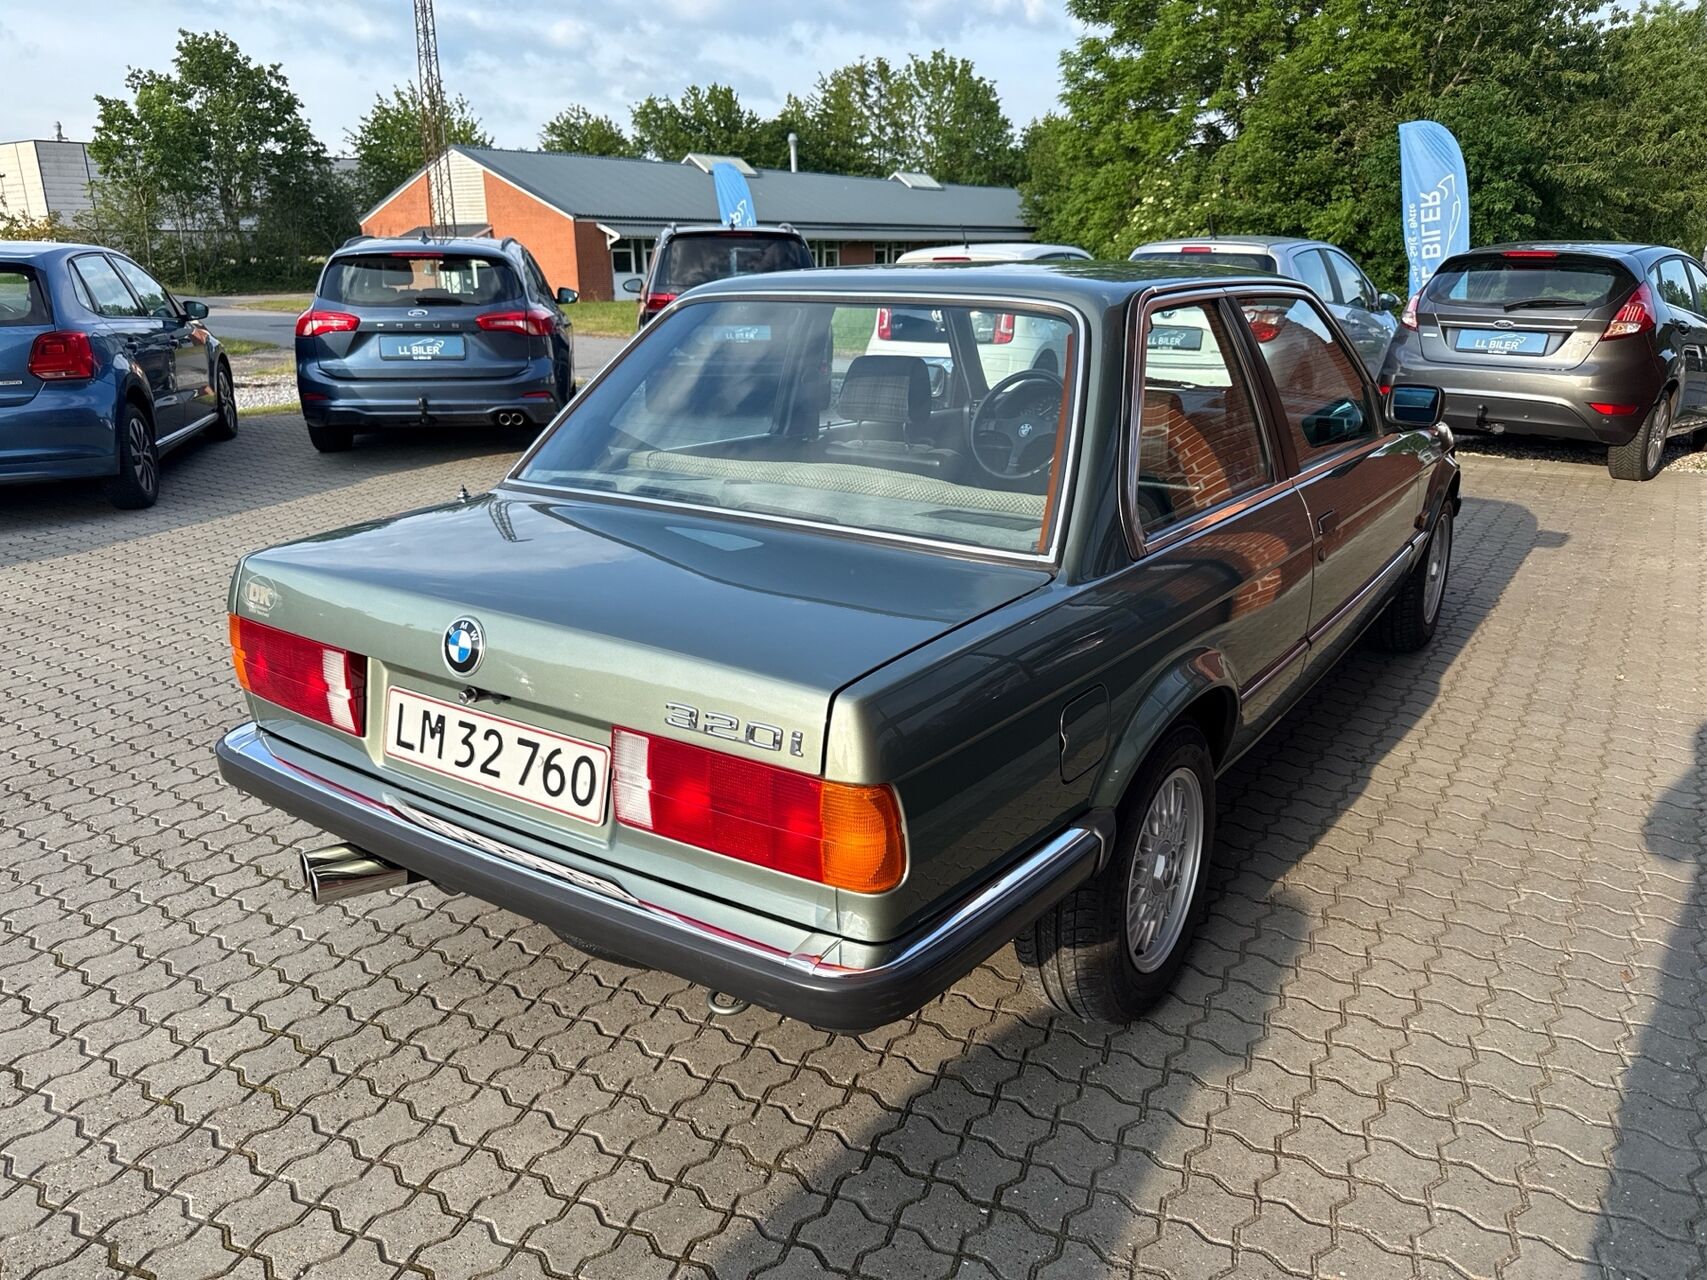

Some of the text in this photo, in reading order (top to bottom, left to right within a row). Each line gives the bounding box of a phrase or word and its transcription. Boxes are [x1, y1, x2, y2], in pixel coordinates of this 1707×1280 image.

[1158, 336, 1180, 346] BILER
[1475, 339, 1519, 350] LL BILER
[398, 346, 440, 355] LL BILER
[448, 621, 479, 641] BMW
[664, 702, 804, 757] 320i
[396, 703, 596, 806] LM 32 760
